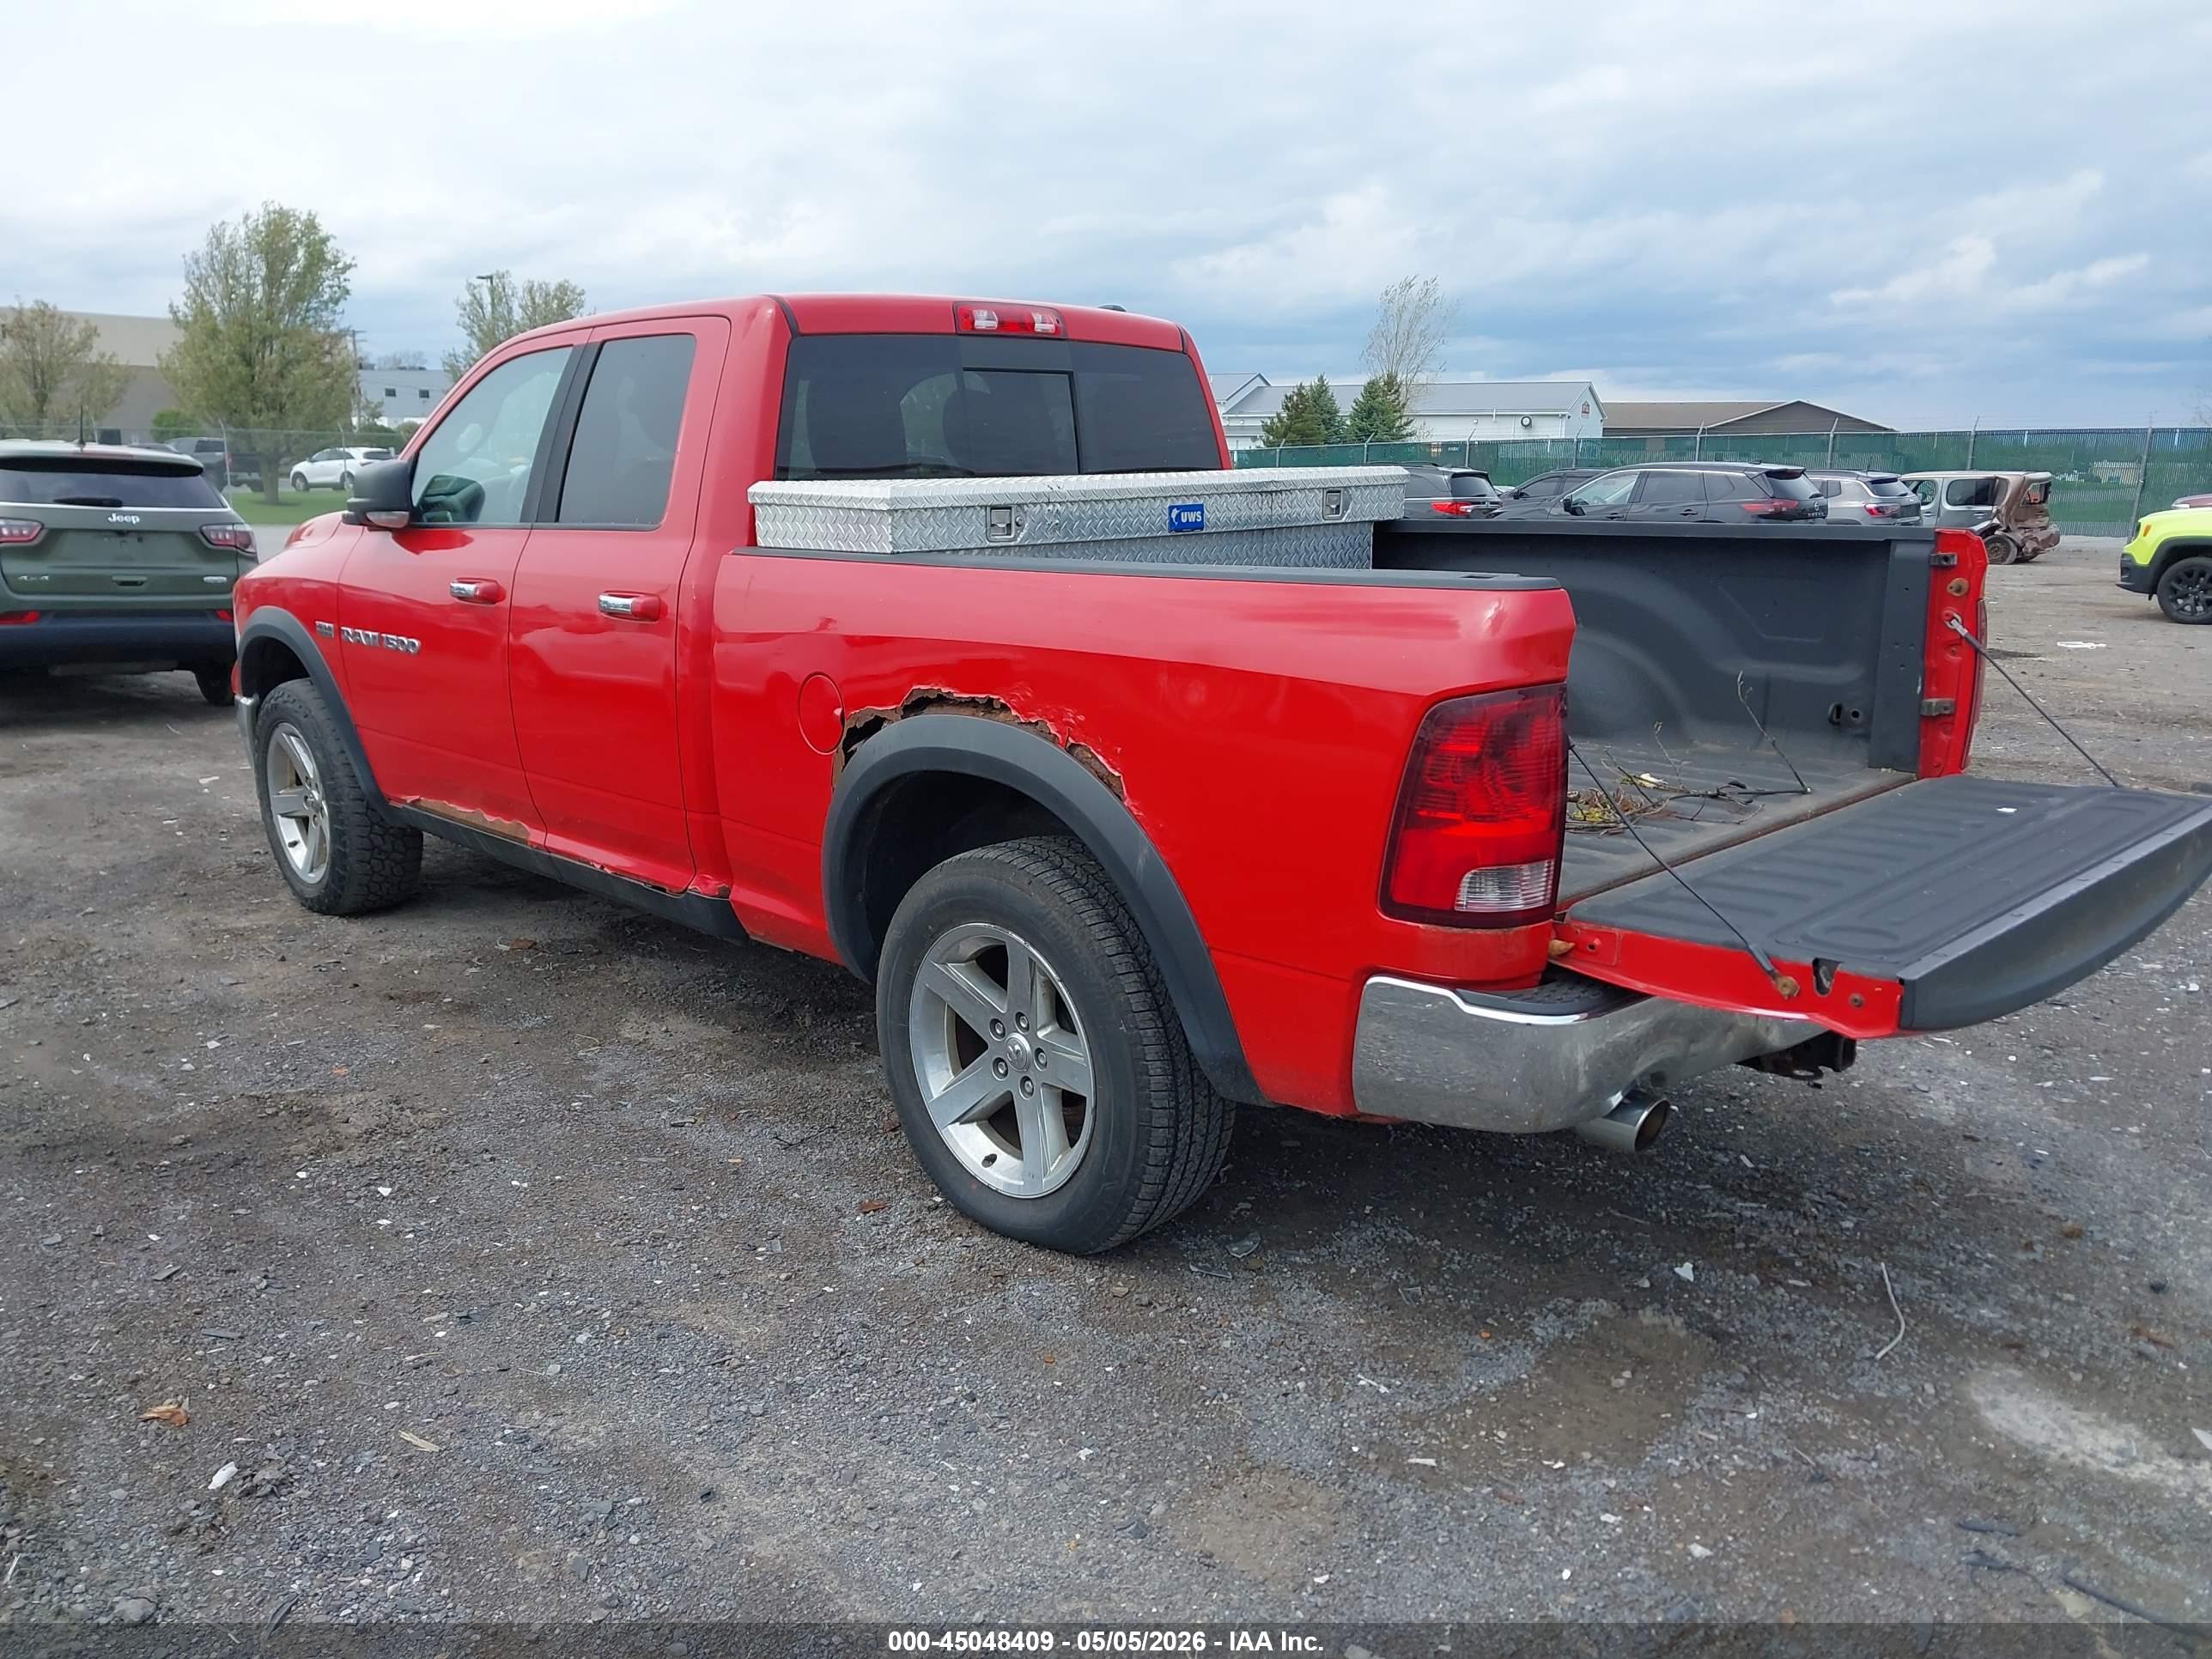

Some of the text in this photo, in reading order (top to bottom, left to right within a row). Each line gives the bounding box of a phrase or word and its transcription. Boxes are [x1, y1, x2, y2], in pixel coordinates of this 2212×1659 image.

[107, 513, 140, 525] Jeep
[1181, 510, 1202, 523] UWS
[341, 626, 380, 646] RAM
[380, 633, 421, 654] 1500
